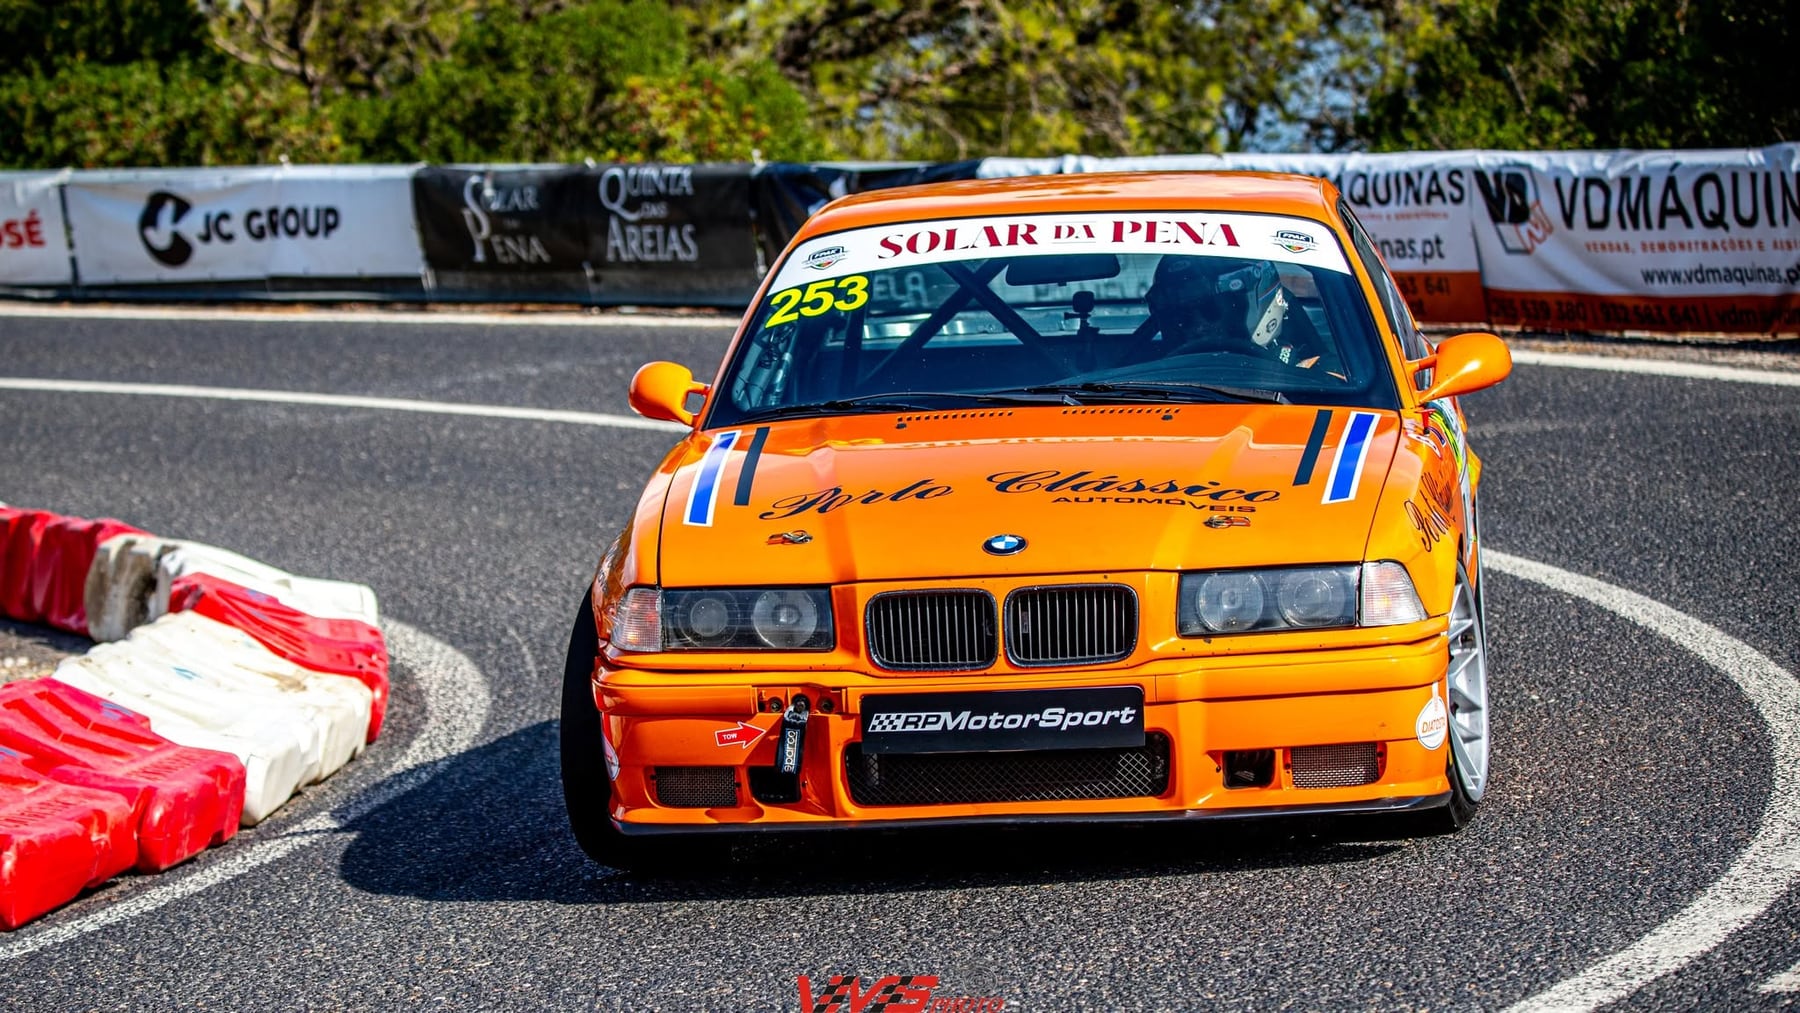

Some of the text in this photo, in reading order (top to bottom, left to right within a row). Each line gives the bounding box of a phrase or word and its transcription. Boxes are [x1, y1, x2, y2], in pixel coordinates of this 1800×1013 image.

[599, 166, 694, 221] QUINTA
[0, 208, 47, 250] SÉ
[197, 206, 340, 244] JC GROUP
[606, 214, 699, 262] AREIAS
[877, 223, 1039, 260] SOLAR
[1053, 223, 1096, 240] DA
[1111, 220, 1241, 248] PENA
[765, 275, 869, 329] 253
[985, 469, 1281, 503] Clássico
[722, 732, 738, 741] TOW
[784, 730, 799, 774] sparco
